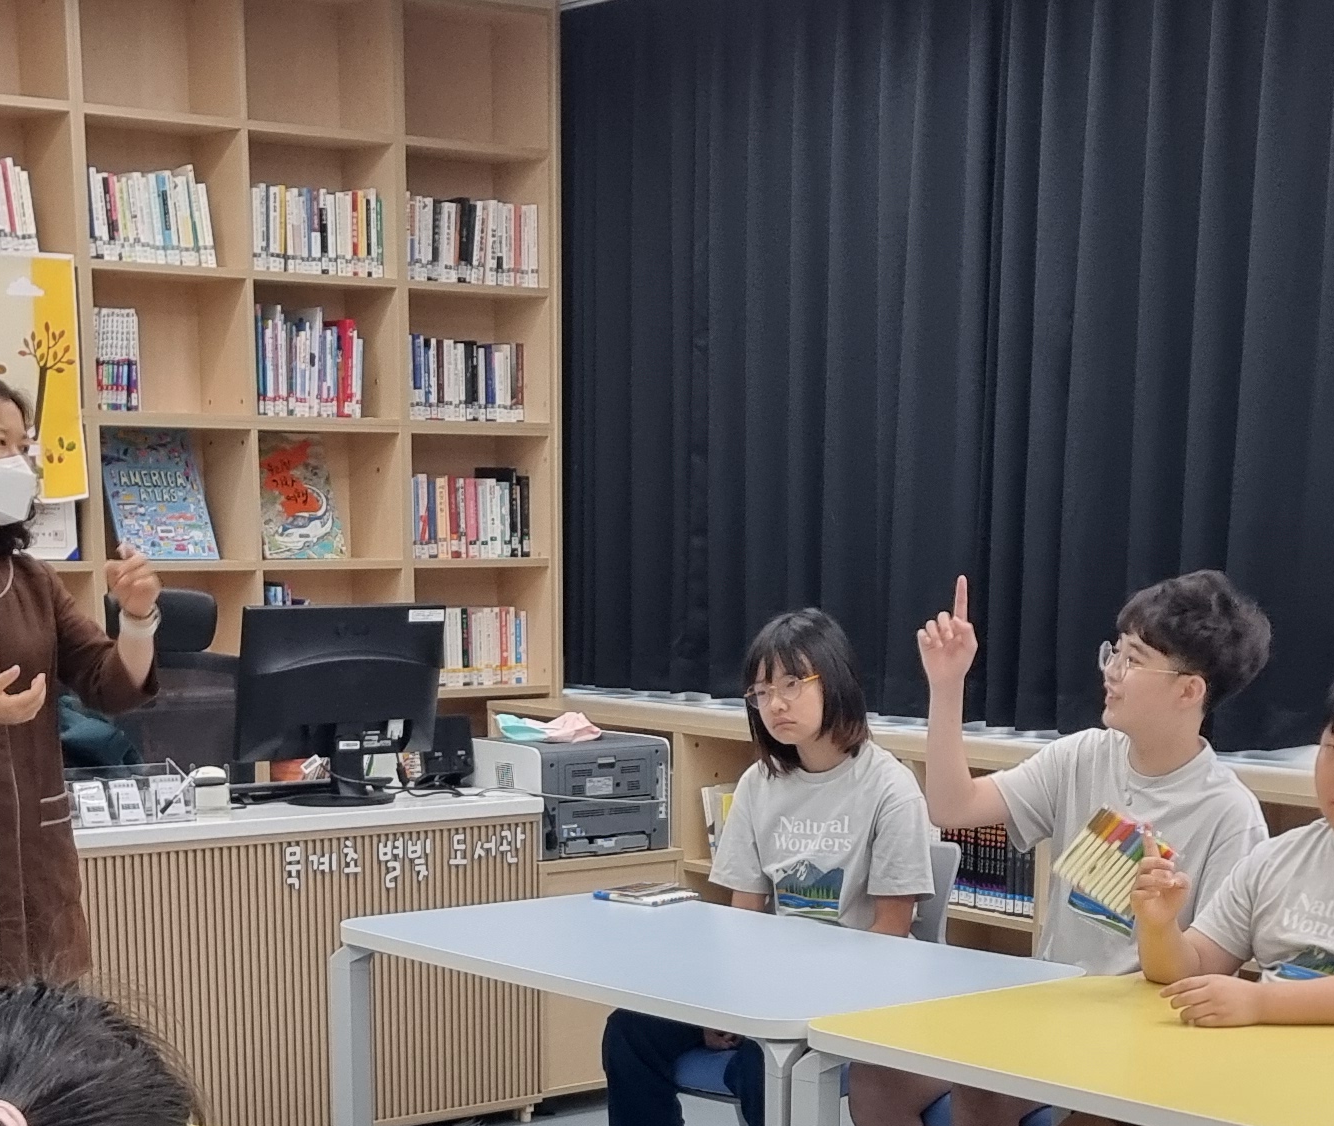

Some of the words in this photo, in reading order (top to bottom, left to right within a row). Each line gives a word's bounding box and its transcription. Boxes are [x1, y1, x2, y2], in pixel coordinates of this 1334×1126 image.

[119, 470, 187, 488] AMERICA
[140, 488, 178, 503] ATLAS
[778, 816, 849, 834] Natural
[773, 833, 852, 852] Wonders
[285, 840, 361, 890] 묵계초
[378, 836, 431, 888] 별빛
[449, 827, 525, 866] 도서관
